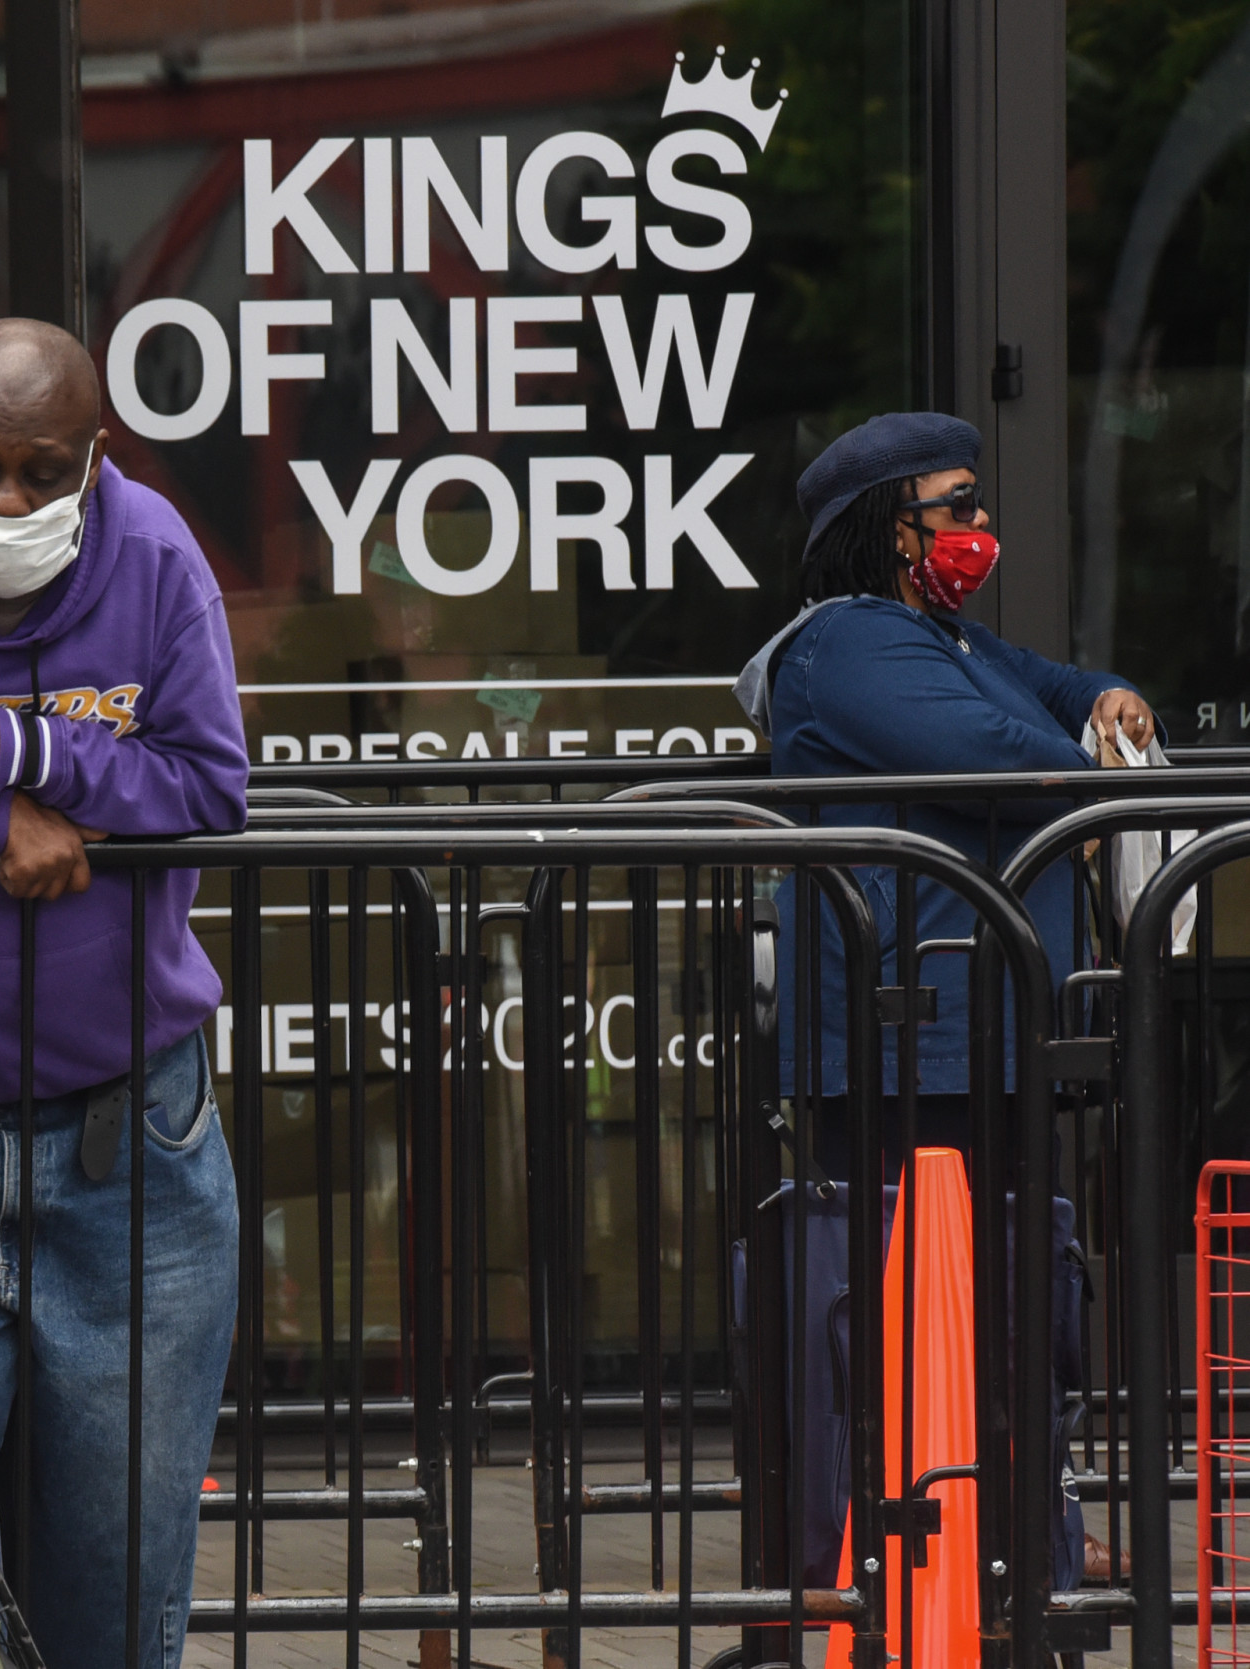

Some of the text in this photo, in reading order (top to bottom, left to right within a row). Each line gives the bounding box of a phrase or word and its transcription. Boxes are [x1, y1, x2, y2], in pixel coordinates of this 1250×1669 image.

[243, 129, 753, 275] KINGS
[106, 292, 756, 441] OF NEW
[288, 452, 760, 596] YORK
